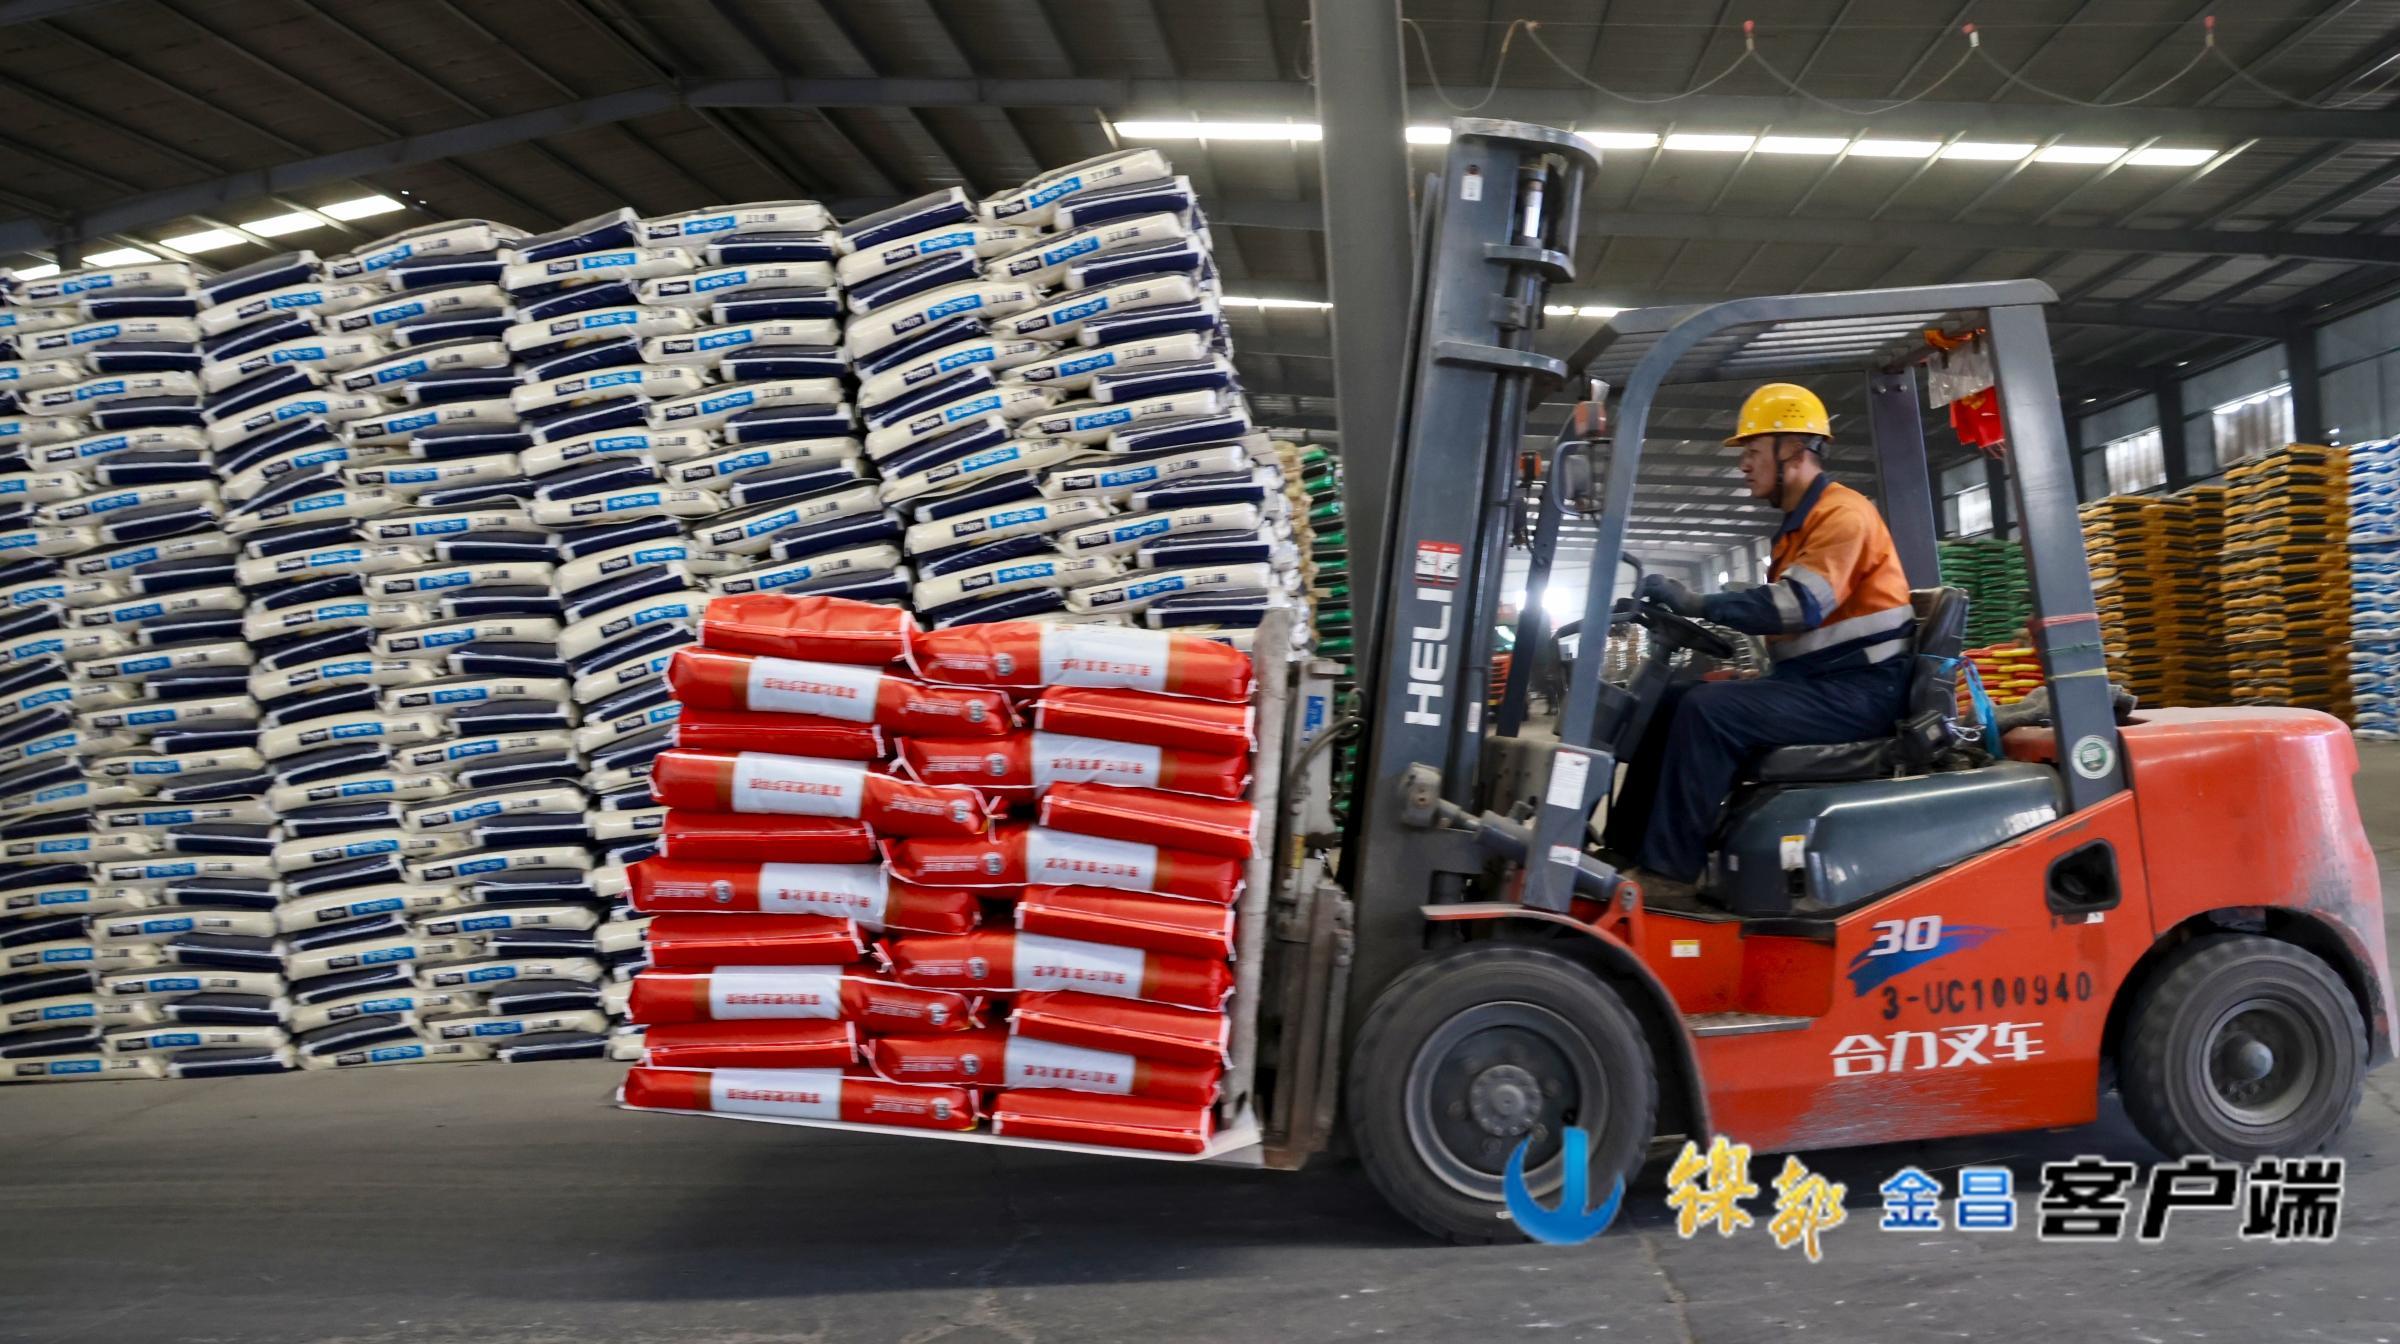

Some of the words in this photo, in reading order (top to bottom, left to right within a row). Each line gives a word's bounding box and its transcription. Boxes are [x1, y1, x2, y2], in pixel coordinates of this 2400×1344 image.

[1404, 587, 1454, 727] HELI
[1867, 915, 1942, 958] 30
[1881, 971, 2093, 1020] 3-UC100940
[1829, 1022, 2046, 1078] 合力叉车
